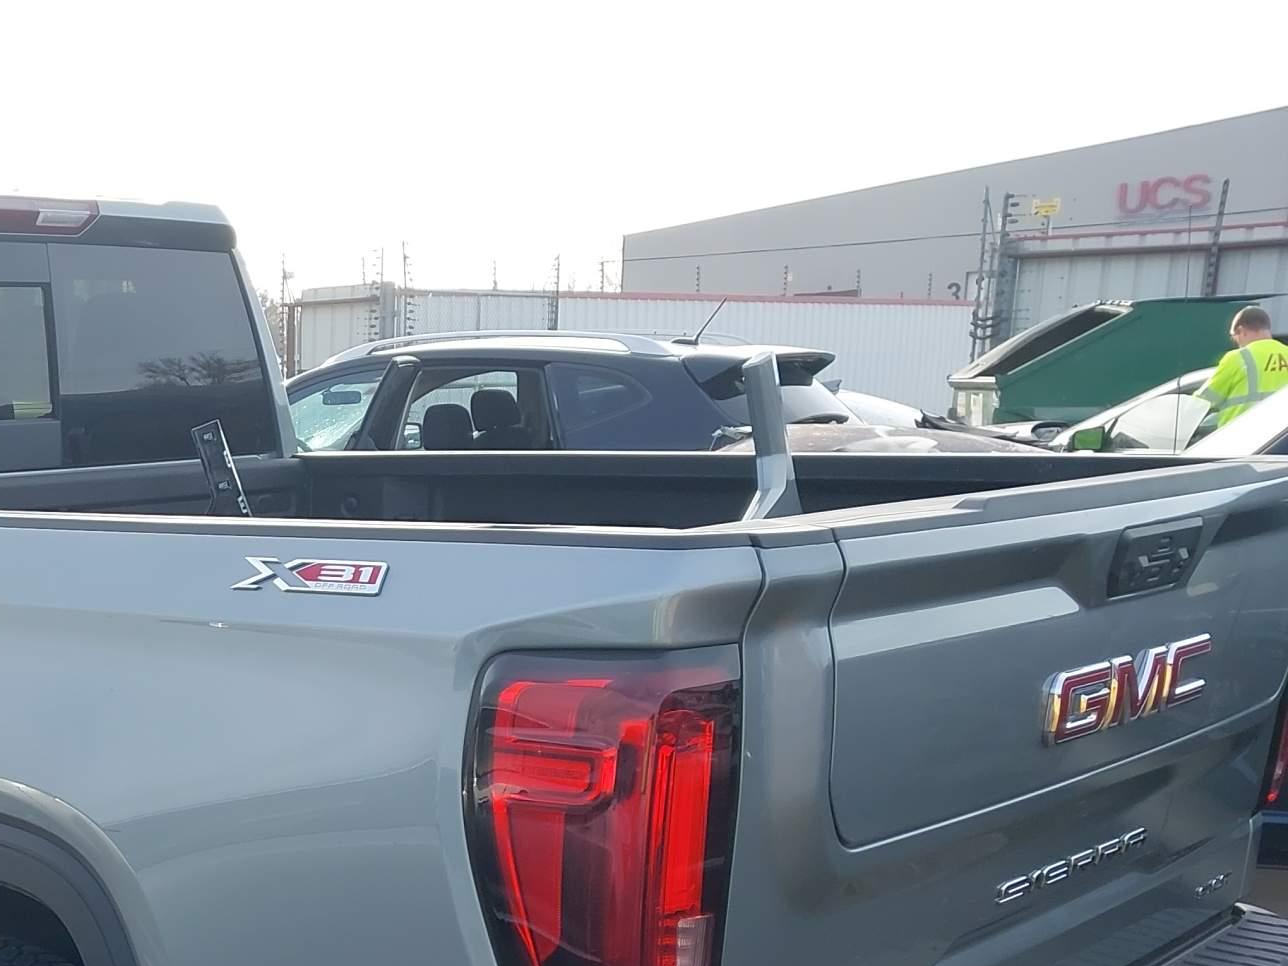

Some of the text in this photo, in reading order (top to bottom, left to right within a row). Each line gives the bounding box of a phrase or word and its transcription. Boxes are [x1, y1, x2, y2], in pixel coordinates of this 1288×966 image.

[1117, 174, 1212, 214] UCS
[230, 556, 376, 593] X31
[1043, 633, 1212, 745] GMC
[995, 827, 1148, 904] SIERRA
